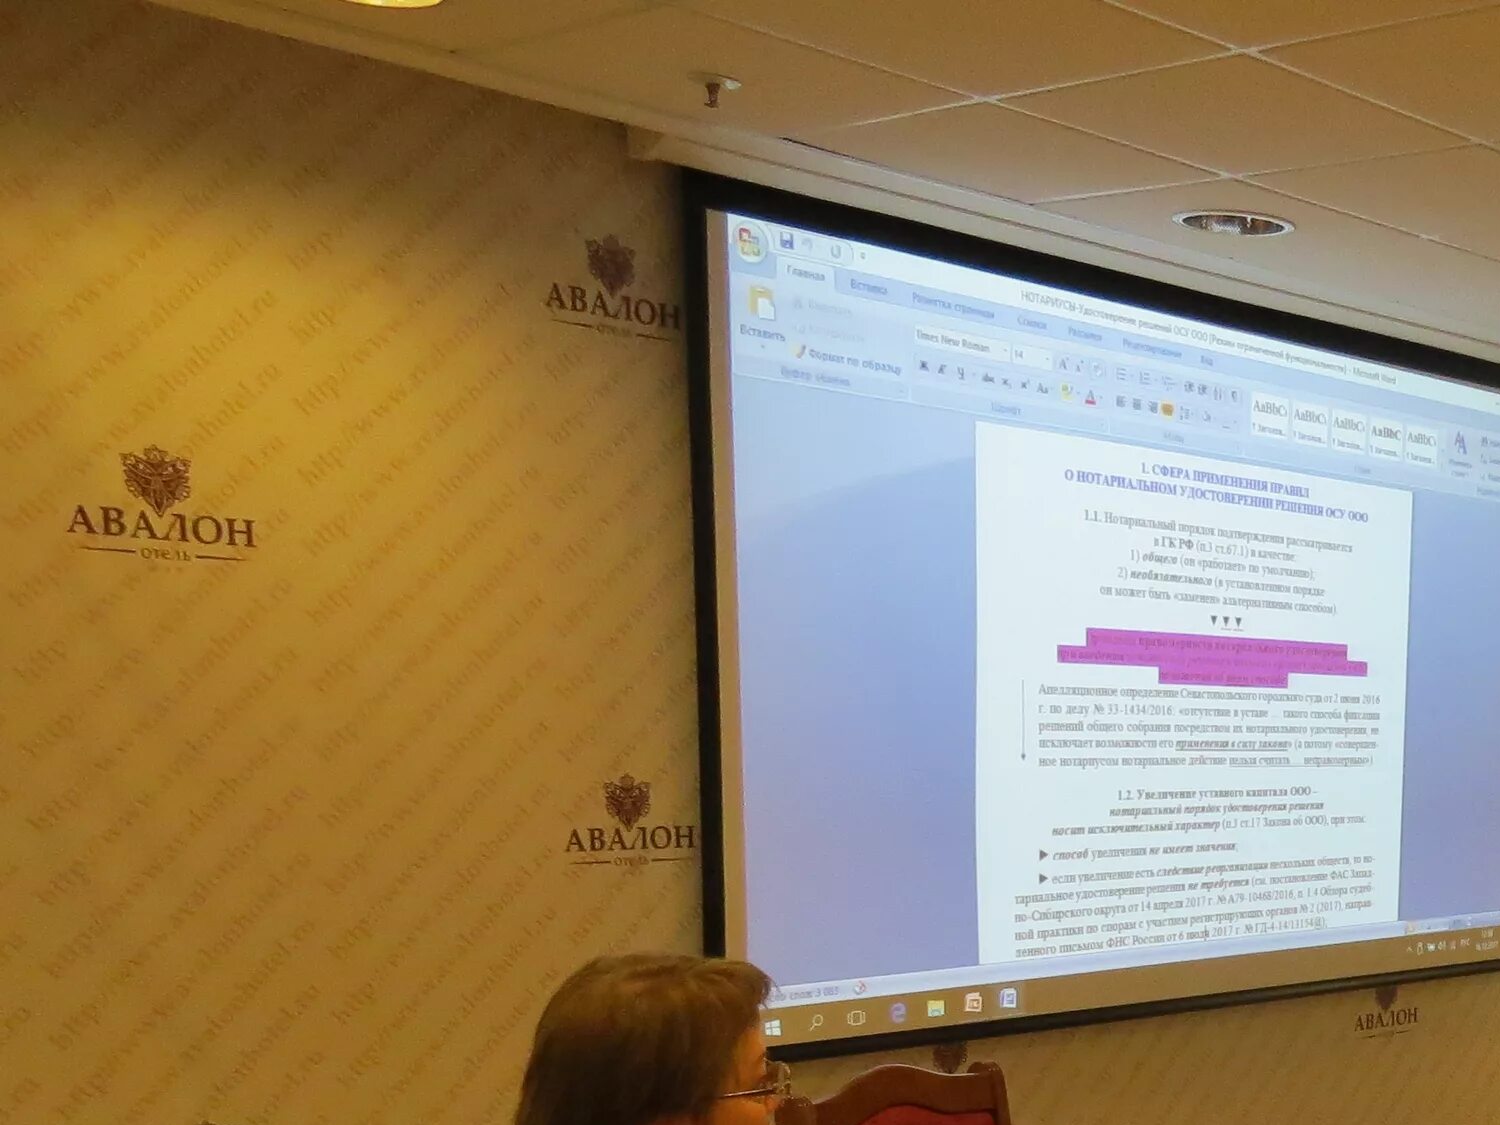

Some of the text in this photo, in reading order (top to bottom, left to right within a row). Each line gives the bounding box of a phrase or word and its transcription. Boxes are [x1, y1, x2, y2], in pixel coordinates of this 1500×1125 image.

[545, 282, 681, 330] АВАЛОН
[739, 323, 786, 343] Вставить
[1173, 324, 1189, 337] ОСУ
[1190, 328, 1208, 341] ООО
[1151, 464, 1190, 480] СФЕРА
[1192, 471, 1268, 492] ПРИМЕНЕНИЯ
[1269, 483, 1309, 498] ПРАВИЛ
[1076, 471, 1176, 495] НОТАРИАЛЬНОМ
[1180, 486, 1273, 509] УДОСТОВЕРЕНИИ
[1275, 500, 1323, 516] РЕШЕНИЯ
[1325, 507, 1344, 519] ОСУ
[1347, 511, 1368, 522] ООО
[67, 505, 258, 548] АВАЛОН
[1084, 510, 1103, 522] 1.1.
[1104, 512, 1176, 531] Нотариальный
[1178, 524, 1215, 536] порядок
[1161, 537, 1176, 548] ГК
[1178, 539, 1194, 550] РФ
[1142, 551, 1177, 564] общего
[1179, 555, 1195, 568] (он
[1130, 569, 1212, 585] необязательного
[1099, 586, 1112, 595] он
[1114, 588, 1145, 598] может
[1148, 588, 1170, 600] быть
[1038, 683, 1118, 697] Апелляционное
[1119, 689, 1179, 700] определение
[1304, 694, 1322, 705] суда
[1362, 694, 1380, 704] 2016
[1049, 705, 1062, 713] по
[1065, 706, 1089, 717] делу
[1086, 721, 1123, 733] общего
[1126, 721, 1171, 735] собрания
[1173, 724, 1230, 735] посредством
[1094, 740, 1157, 748] возможности
[1158, 740, 1173, 748] его
[1038, 758, 1056, 766] ное
[1059, 758, 1119, 769] нотариусом
[1121, 757, 1186, 768] нотариальное
[1188, 755, 1227, 767] действие
[1118, 786, 1311, 801] 1.2. Увеличение уставного капитала ООО
[1109, 802, 1324, 818] нотариальный порядок удостоверения решения
[1051, 826, 1085, 835] носит
[1087, 820, 1173, 834] исключительный
[1174, 821, 1220, 833] характер
[565, 825, 696, 852] АВАЛОН
[1052, 848, 1088, 860] способ
[1091, 847, 1147, 861] увеличения
[1162, 845, 1193, 854] имеет
[1052, 874, 1076, 883] если
[1077, 870, 1134, 885] увеличение
[1134, 869, 1154, 878] есть
[1014, 891, 1074, 906] тариальное
[1075, 886, 1145, 902] удостоверение
[1145, 883, 1185, 896] решения
[1200, 878, 1249, 892] требуется
[1329, 869, 1348, 879] ФАС
[1014, 908, 1092, 922] но-Сибирского
[1093, 905, 1126, 917] округа
[1152, 900, 1183, 912] апреля
[1185, 896, 1205, 907] 2017
[1014, 928, 1034, 940] ной
[1036, 926, 1084, 941] практики
[1085, 925, 1098, 933] по
[1100, 921, 1136, 933] спорам
[1146, 916, 1188, 931] участием
[1189, 909, 1263, 927] регистрирующих
[1015, 946, 1056, 957] ленного
[1058, 941, 1103, 953] письмом
[1105, 936, 1130, 948] ФНС
[1132, 935, 1165, 945] России
[1211, 926, 1232, 937] 2017
[1354, 1008, 1418, 1032] АВАЛОН
